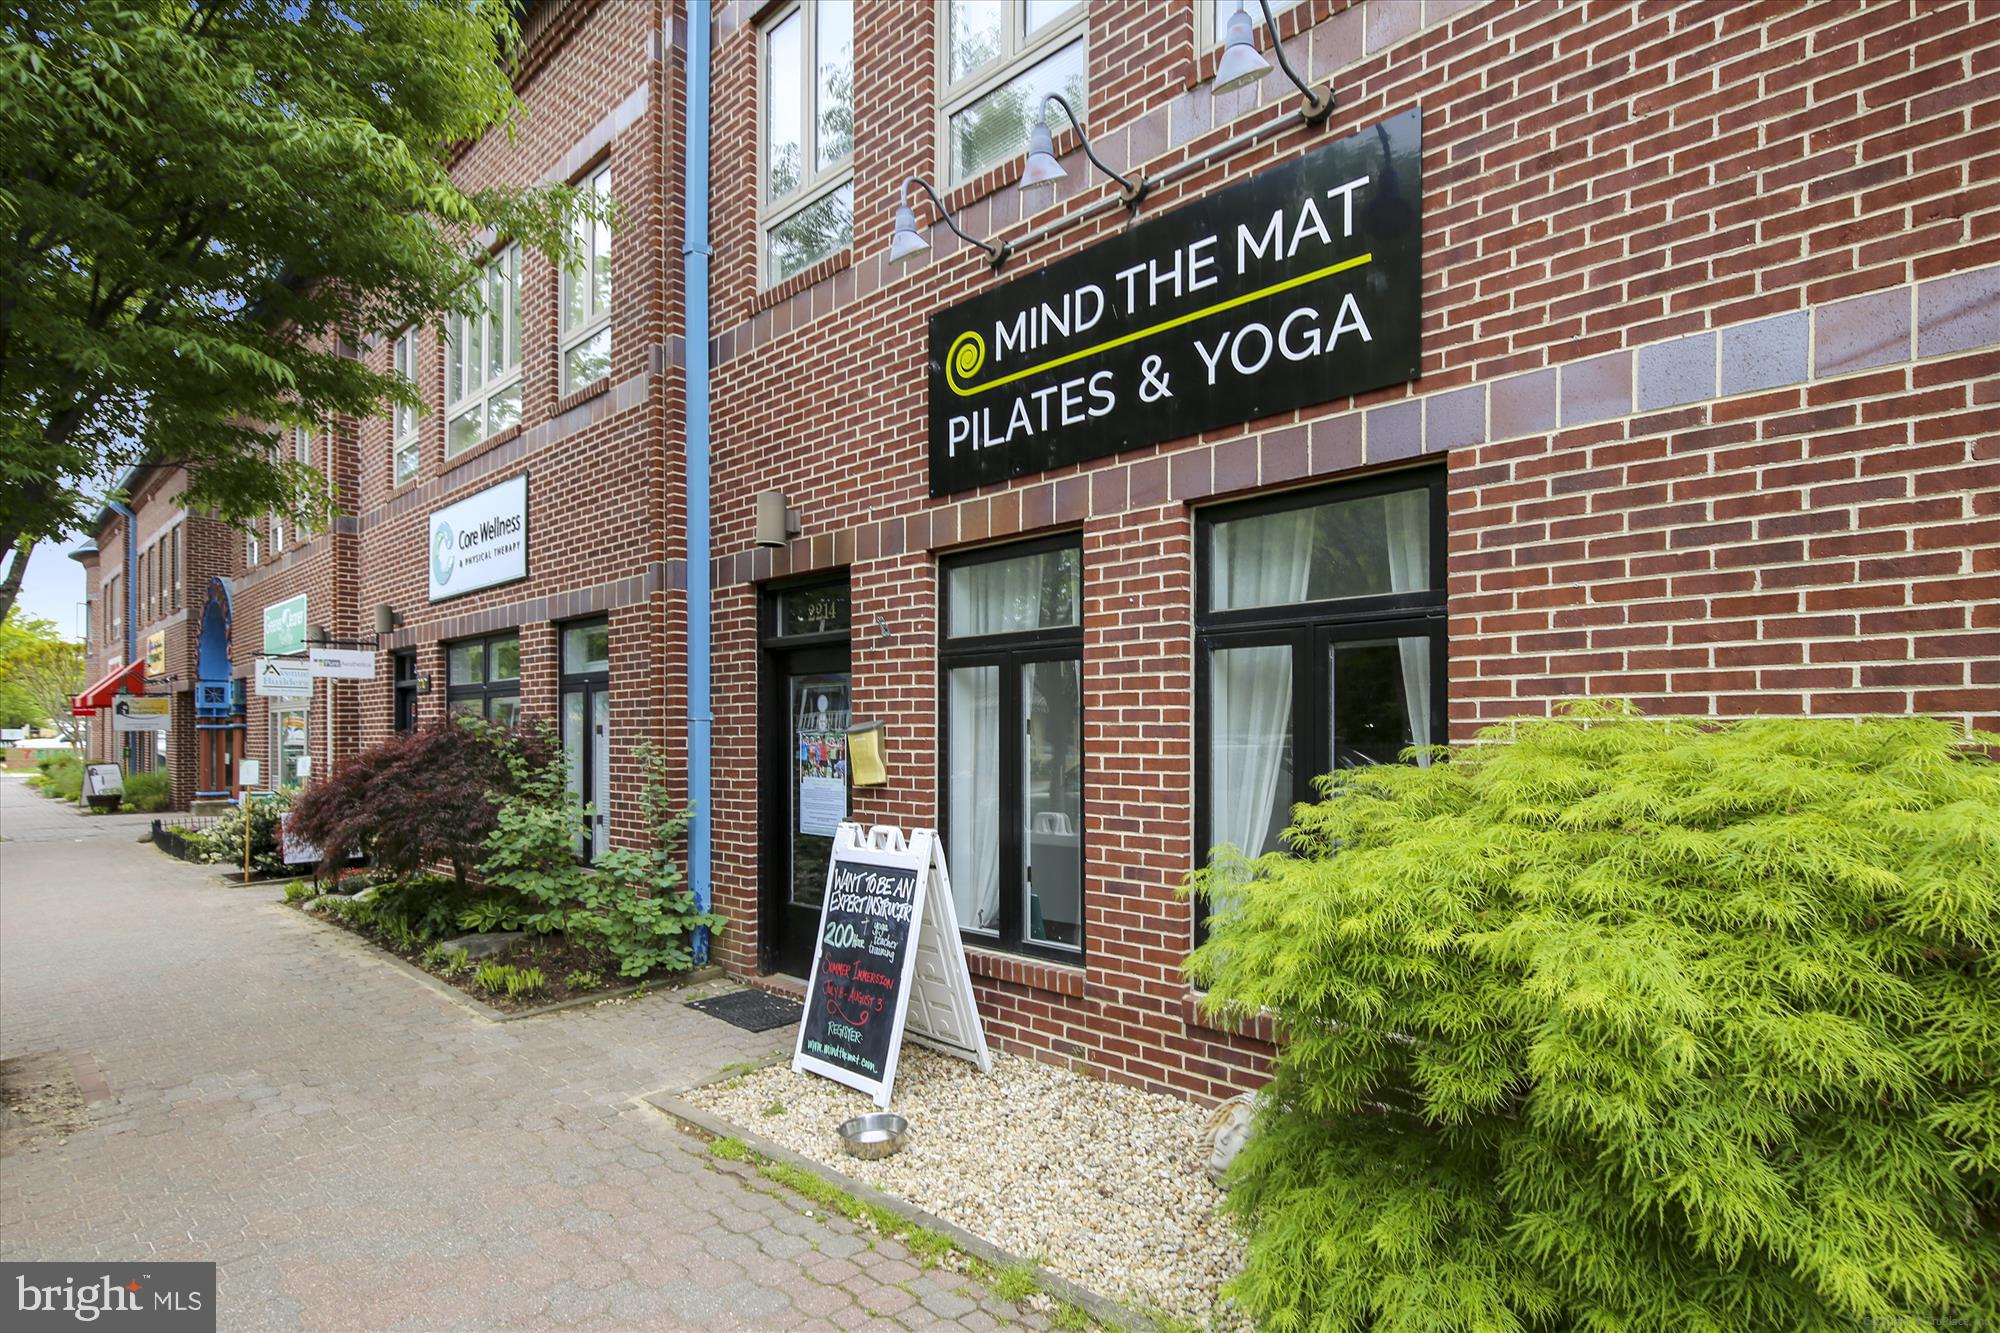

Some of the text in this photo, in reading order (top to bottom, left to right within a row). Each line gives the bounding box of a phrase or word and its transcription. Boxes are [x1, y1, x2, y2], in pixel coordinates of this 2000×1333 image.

[995, 175, 1370, 362] MIND THE MAT
[948, 292, 1373, 458] PILATES & YOGA
[459, 514, 521, 550] Core Wellness
[465, 551, 492, 566] PHYSICAL
[494, 540, 521, 557] THERAPY
[808, 601, 836, 622] 2214
[834, 868, 916, 901] WANT TO BE AN
[829, 889, 868, 914] EXPERT
[824, 921, 854, 949] 200
[871, 921, 889, 937] yoga
[873, 934, 899, 949] teacher
[868, 940, 896, 964] training
[847, 986, 875, 1010] AUGUST
